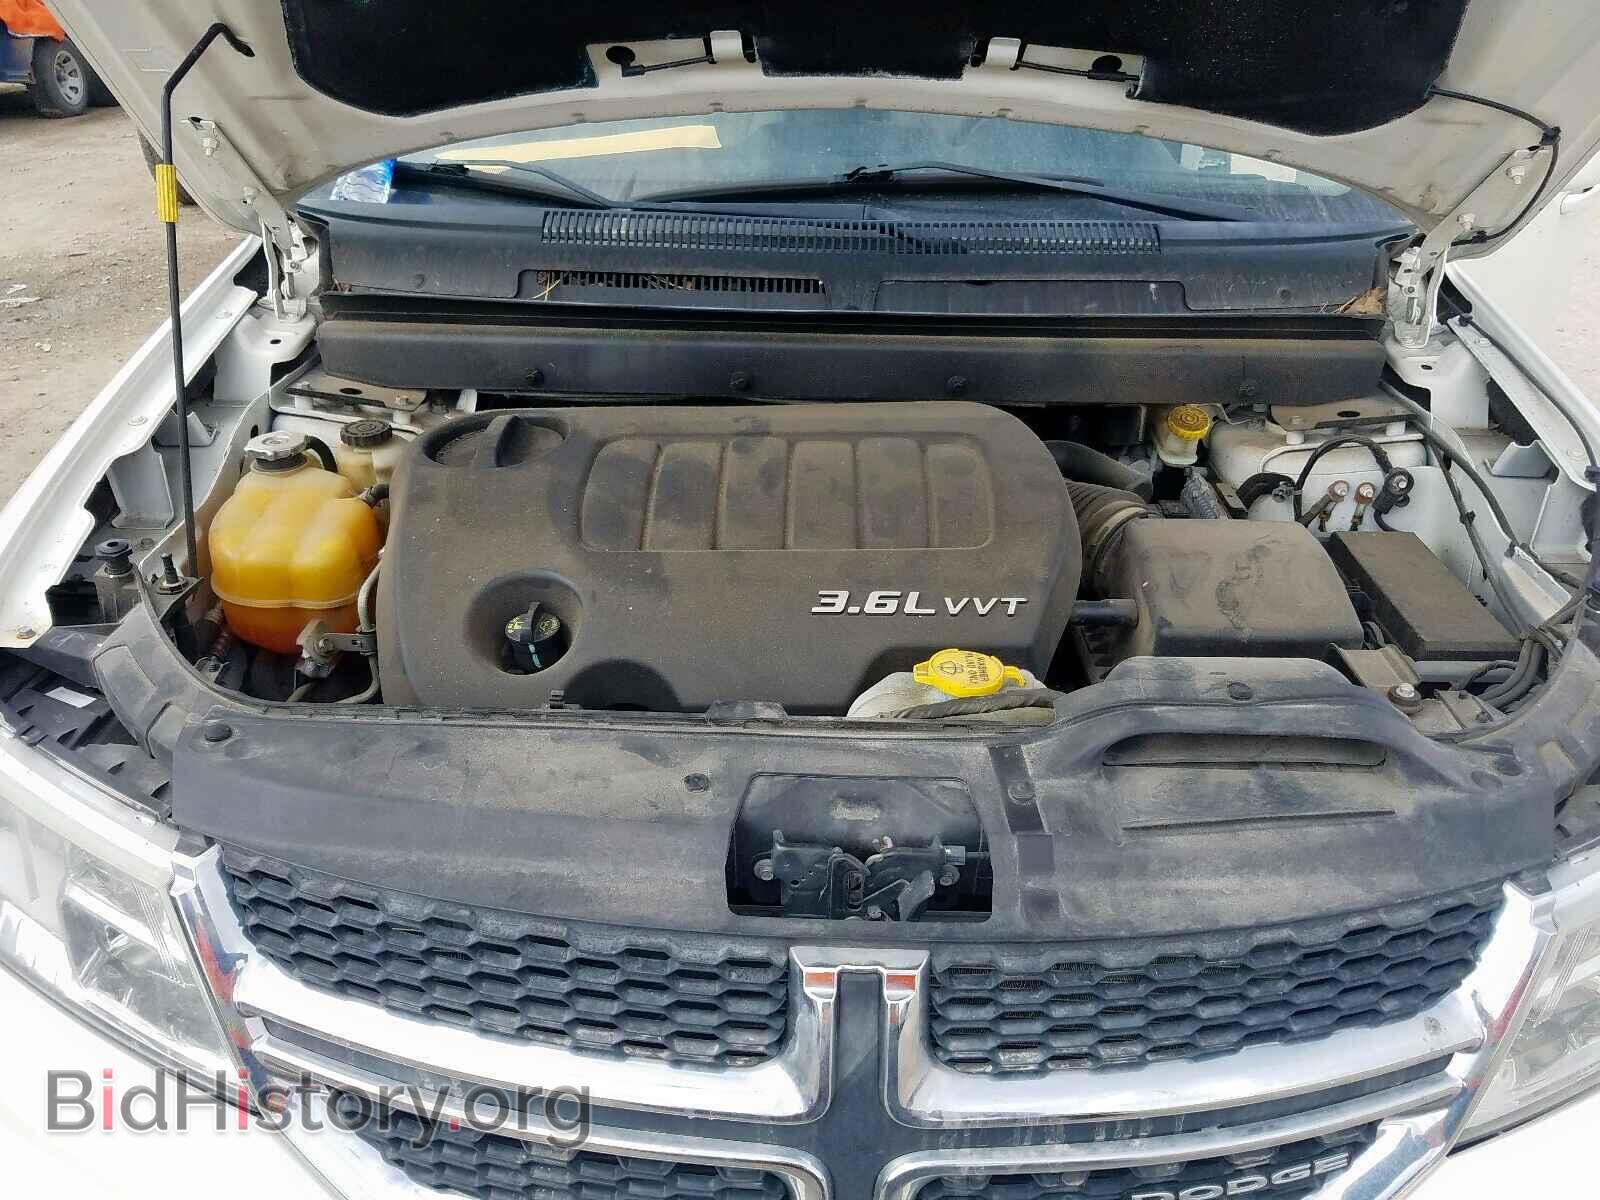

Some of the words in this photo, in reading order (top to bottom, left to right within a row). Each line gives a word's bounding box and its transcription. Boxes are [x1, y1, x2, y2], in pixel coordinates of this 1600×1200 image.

[811, 590, 936, 615] 3.6L
[943, 597, 1028, 616] VVT
[977, 656, 989, 682] WASHER
